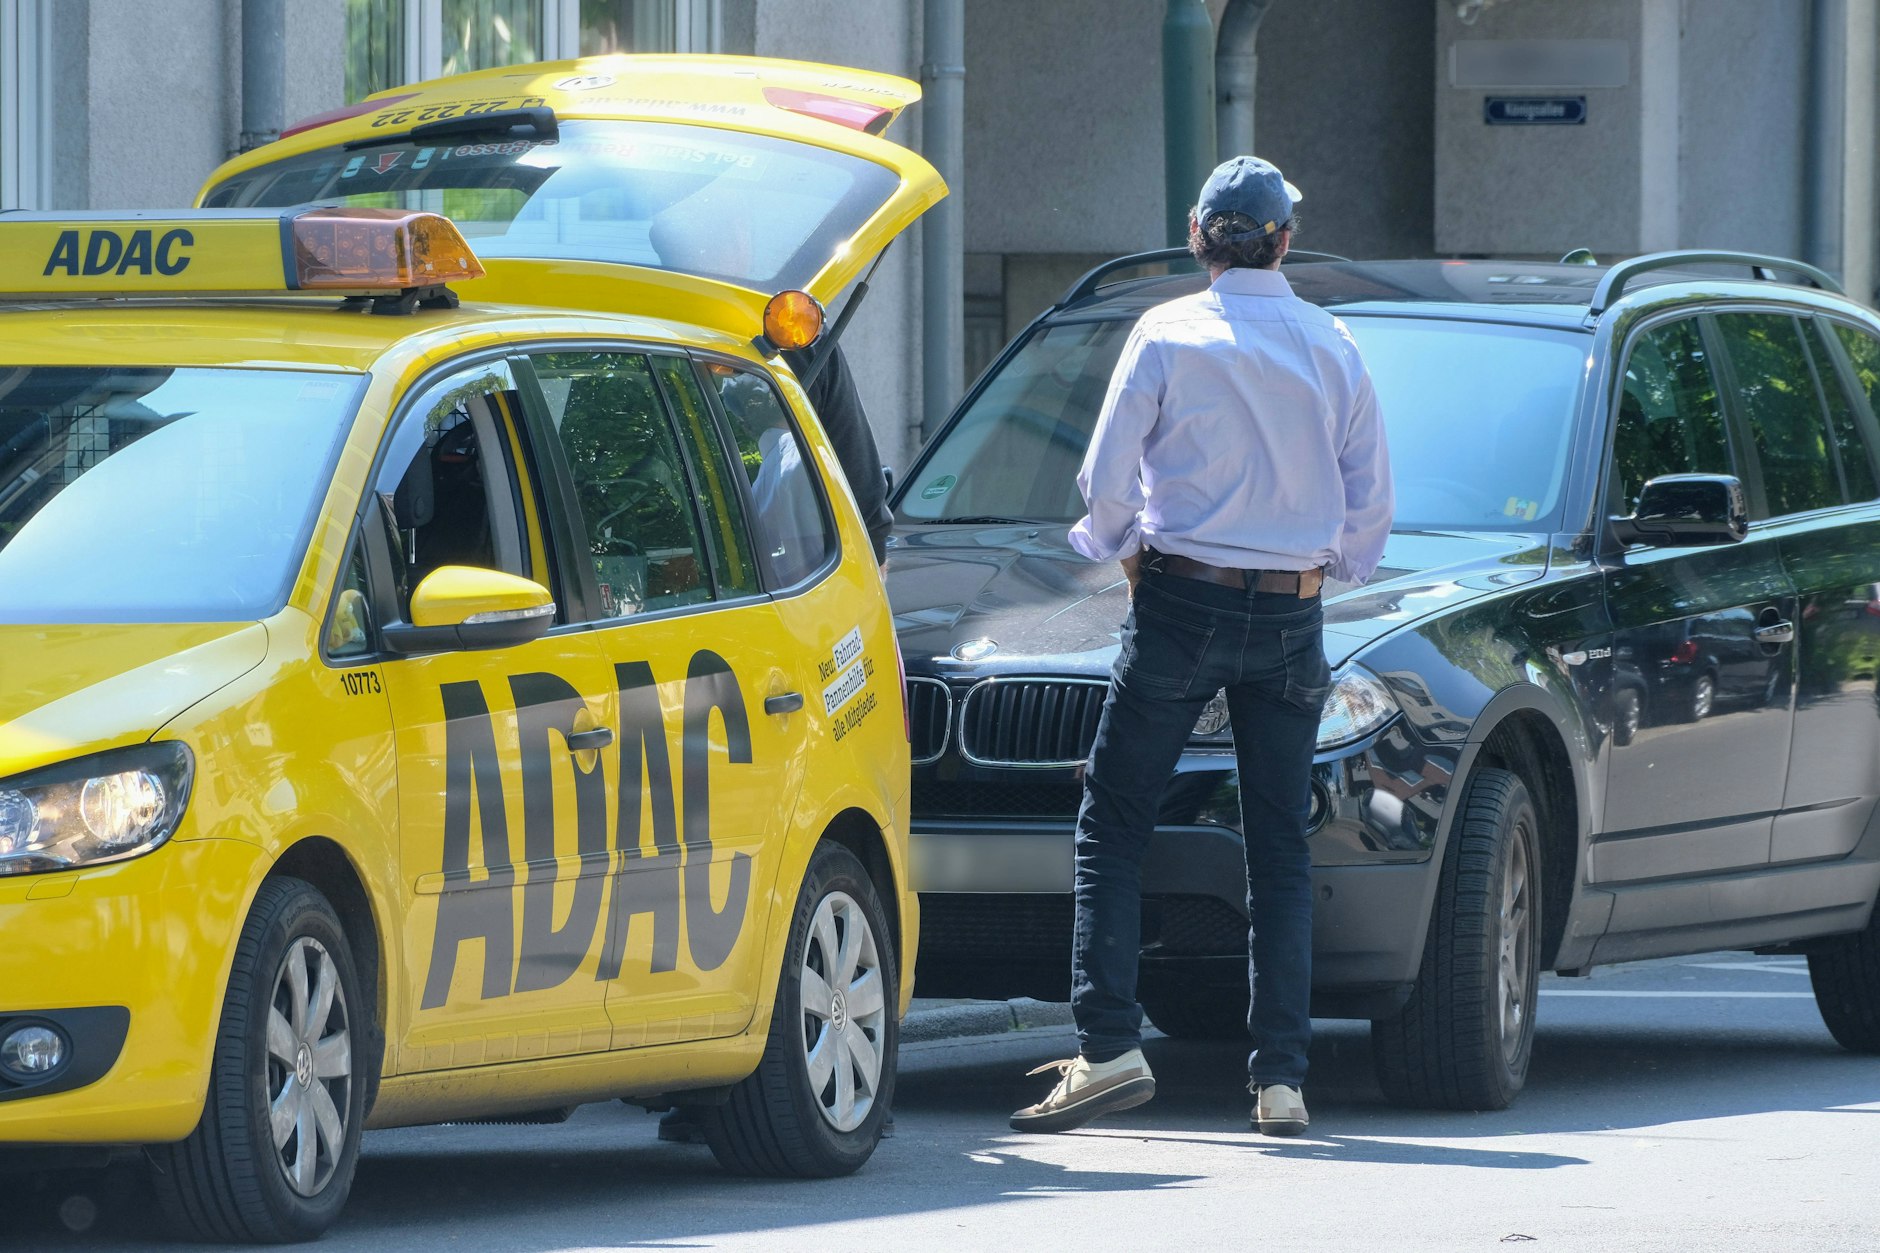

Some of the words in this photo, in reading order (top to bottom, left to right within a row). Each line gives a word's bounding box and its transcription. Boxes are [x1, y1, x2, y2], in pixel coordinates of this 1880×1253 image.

[371, 110, 416, 128] 22
[417, 105, 467, 121] 22
[43, 228, 195, 276] ADAC
[818, 658, 836, 683] Neu:
[834, 630, 862, 669] Fahrrad-
[340, 671, 382, 696] 10773
[824, 664, 865, 713] Pannenhilfe
[863, 656, 875, 680] für
[832, 717, 847, 743] alle
[844, 692, 878, 733] Mitglieder.
[420, 648, 753, 1011] ADAC
